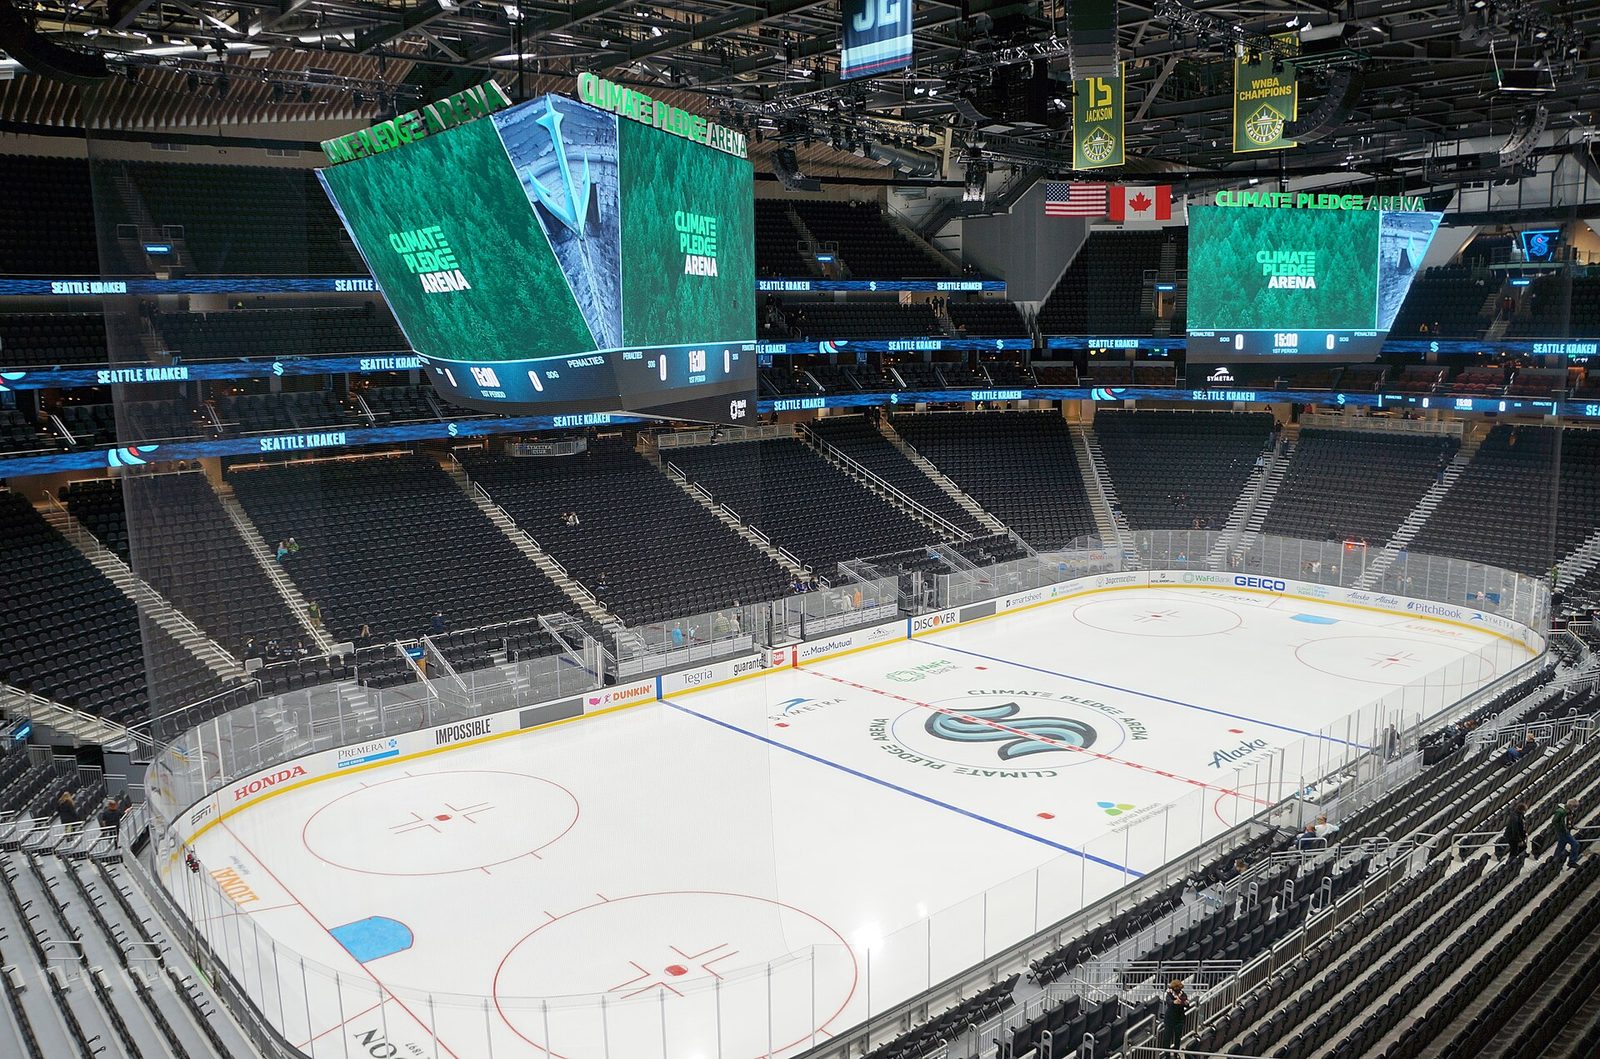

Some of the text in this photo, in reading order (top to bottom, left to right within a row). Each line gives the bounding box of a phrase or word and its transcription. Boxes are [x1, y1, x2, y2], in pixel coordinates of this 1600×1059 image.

[1252, 77, 1280, 89] WNBA
[1239, 85, 1292, 101] CHAMPIONS
[358, 110, 426, 156] PLEDGE
[422, 79, 514, 136] ARENA
[577, 72, 748, 158] CLIMATE PLEDGE ARENA
[1085, 106, 1113, 123] JACKSON
[1215, 190, 1426, 211] CLIMATE PLEDGE ARENA
[674, 210, 717, 237] CLIMATE
[389, 225, 449, 254] CLIMATE
[680, 232, 717, 257] PLEDGE
[402, 247, 460, 274] PLEDGE
[684, 254, 719, 277] ARENA
[1256, 251, 1316, 264] CLIMATE
[1263, 263, 1315, 277] PLEDGE
[51, 281, 127, 294] SEATTLE KRAKEN
[335, 280, 374, 291] SEATTLE
[419, 269, 472, 293] ARENA
[759, 280, 810, 291] SEATTLE KRAKEN
[936, 281, 983, 291] SEATTLE KRAKEN
[1268, 276, 1316, 289] ARENA
[888, 340, 941, 350] SEATTLE KRAKEN
[1088, 339, 1139, 348] SEATTLE KRAKEN
[1235, 334, 1244, 350] 0
[1273, 333, 1298, 348] 15:00
[1326, 334, 1334, 350] 0
[1533, 343, 1597, 354] SEATTLE KRAKEN
[360, 358, 395, 371] SEATTLE
[395, 357, 424, 369] KRAKE
[566, 356, 605, 369] PENALTIES
[97, 367, 188, 384] SEATTLE KRAKEN
[545, 370, 560, 379] SOG
[971, 390, 1022, 400] SEATTLE KRAKEN
[1226, 391, 1255, 401] KRAKEN
[773, 398, 826, 411] SEATTLE KRAKEN
[552, 413, 611, 427] SEATTLE KRAKEN
[260, 432, 346, 451] SEATTLE KRAKEN
[1234, 575, 1286, 592] GEICO
[1415, 602, 1462, 620] PitchBook
[913, 612, 956, 631] DISCOVER
[1484, 615, 1515, 630] SYMETRA
[810, 637, 853, 655] MassMutual
[683, 668, 713, 685] Tegria
[612, 684, 653, 702] DUNKIN'
[768, 698, 847, 721] SYMETRA
[967, 689, 1149, 741] CLIMATE PLEDGE ARENA
[435, 718, 491, 746] IMPOSSIBLE
[338, 743, 384, 760] PREMERA
[869, 718, 1058, 779] CLIMATE PLEDGE ARENA
[1207, 738, 1268, 769] Alaska
[233, 765, 308, 802] HONDA
